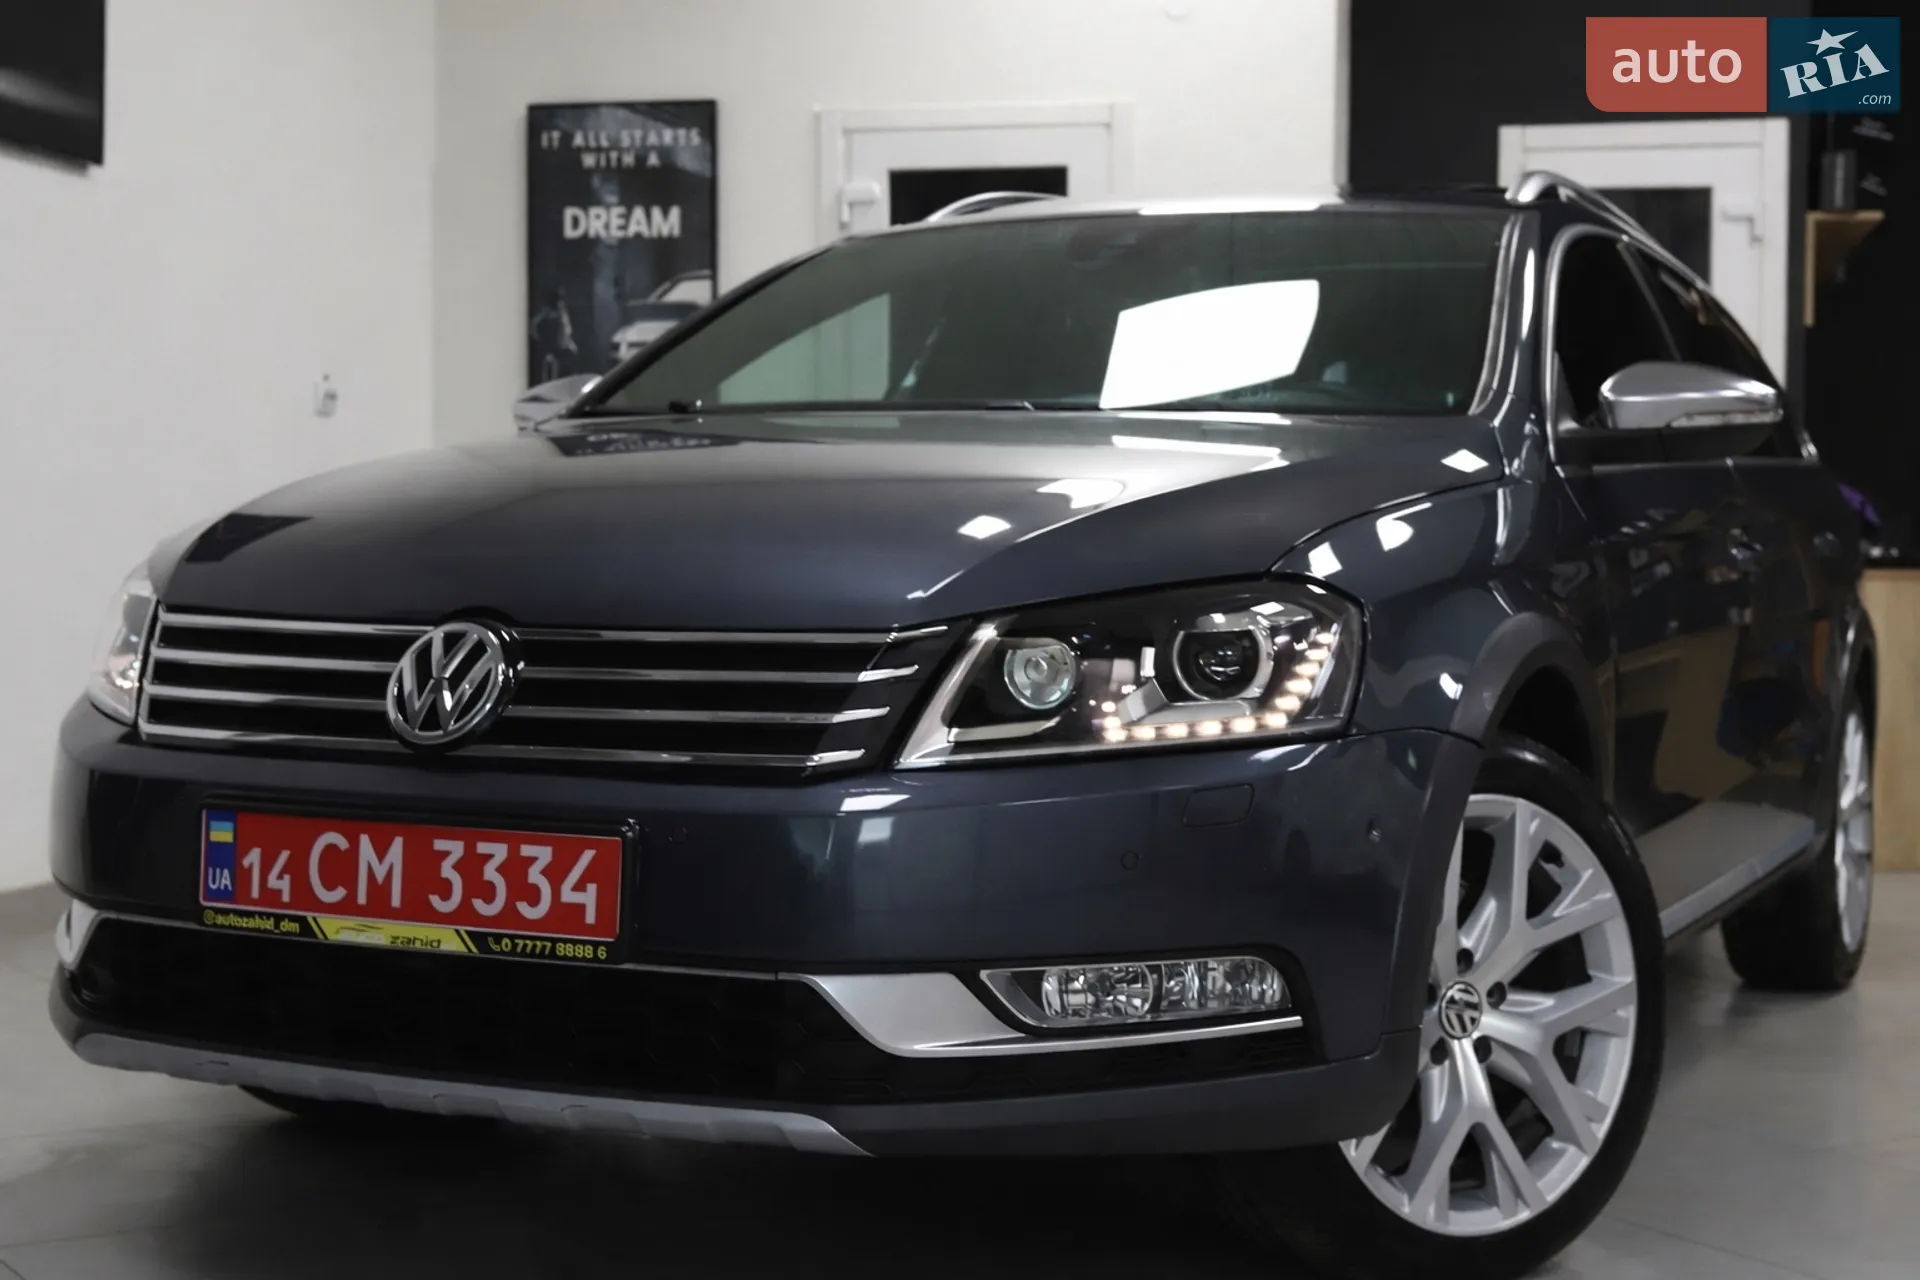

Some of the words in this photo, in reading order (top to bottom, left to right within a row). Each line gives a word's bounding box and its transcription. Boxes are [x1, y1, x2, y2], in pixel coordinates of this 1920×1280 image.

[541, 130, 561, 148] IT
[572, 130, 609, 148] ALL
[620, 127, 701, 147] STARTS
[581, 151, 636, 169] WITH
[646, 150, 661, 168] A
[563, 205, 682, 239] DREAM
[208, 867, 233, 891] UA
[242, 847, 291, 903] 14
[308, 831, 404, 908] CM
[428, 839, 598, 925] 3334
[501, 940, 512, 952] 0
[516, 939, 551, 955] 7777
[556, 942, 593, 958] 8888
[597, 946, 607, 960] 6
